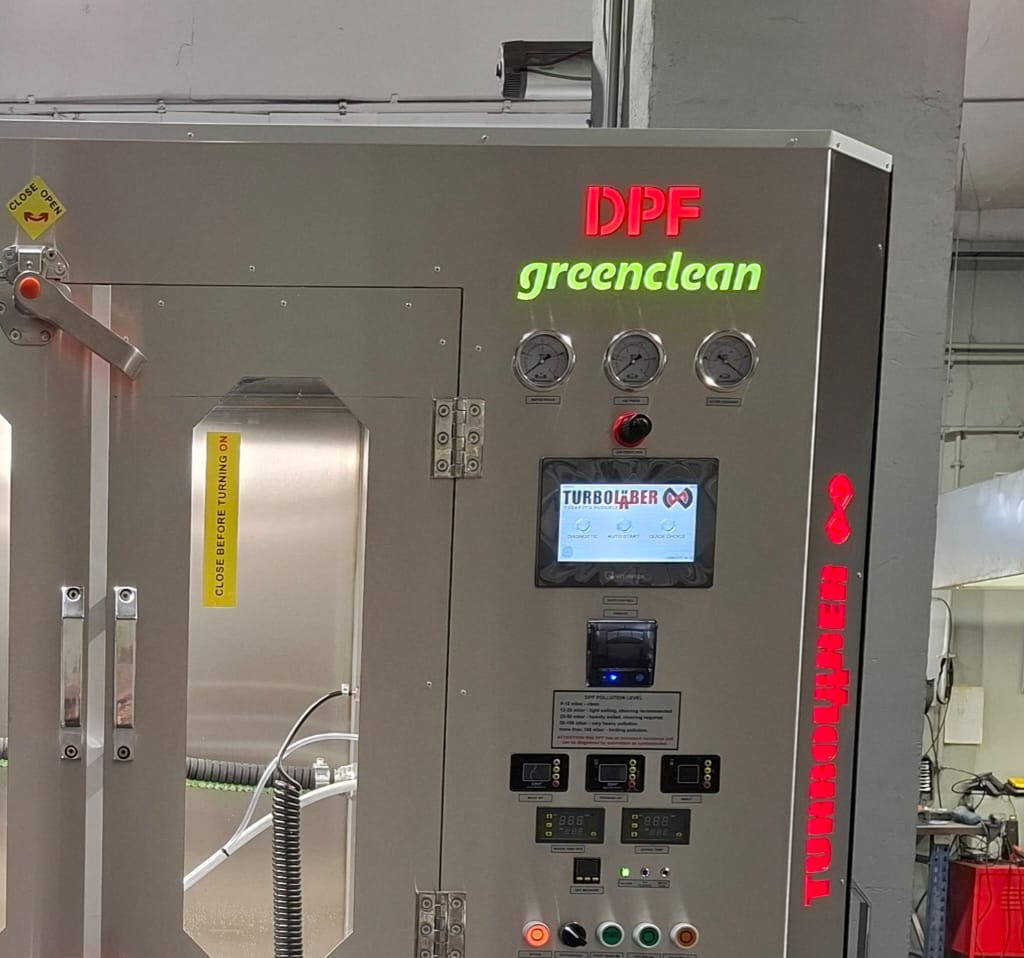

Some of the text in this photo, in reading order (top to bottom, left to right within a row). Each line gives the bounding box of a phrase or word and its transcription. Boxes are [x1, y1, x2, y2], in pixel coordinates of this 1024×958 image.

[9, 183, 63, 215] CLOSE OPEN
[584, 185, 702, 237] DPF
[516, 251, 762, 300] greenclean
[215, 435, 229, 597] CLOSE BEFORE TURNING ON
